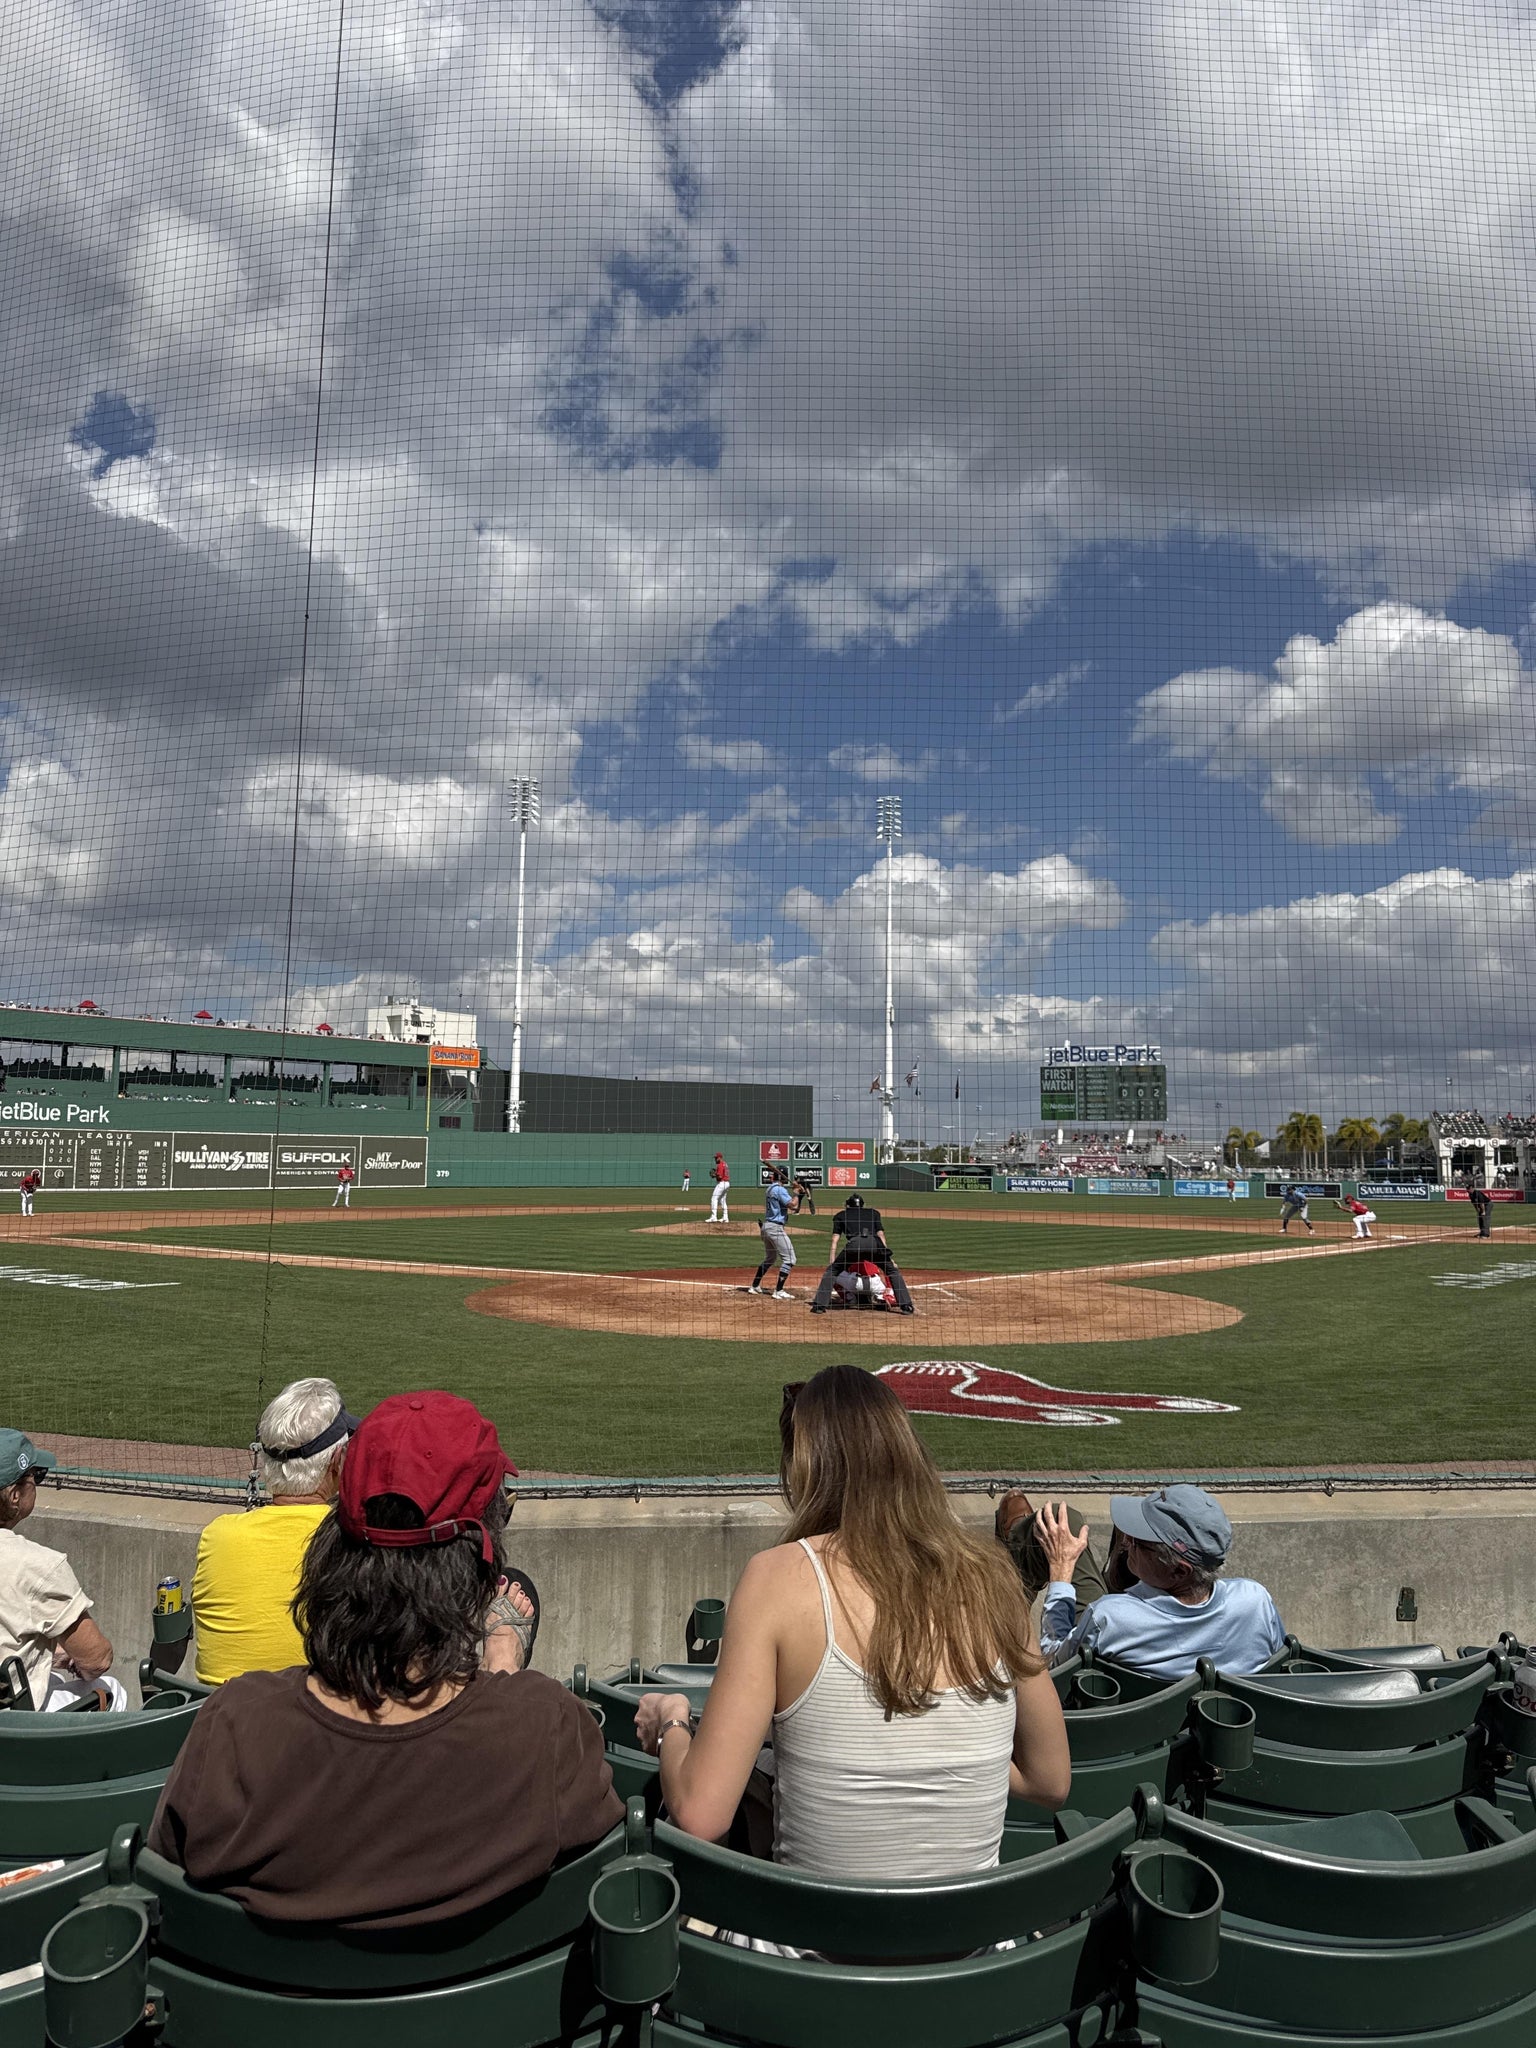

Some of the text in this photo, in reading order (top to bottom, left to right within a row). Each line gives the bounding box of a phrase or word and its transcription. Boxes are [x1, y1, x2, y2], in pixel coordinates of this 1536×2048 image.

[1048, 1045, 1158, 1066] jetBlue Park
[1044, 1069, 1072, 1080] FIRST
[1041, 1080, 1074, 1091] WATCH
[1153, 1089, 1160, 1097] 2
[67, 1104, 110, 1124] Park
[78, 1132, 132, 1140] LEAGUE
[174, 1151, 269, 1163] SULLIVAN TIRE
[281, 1152, 351, 1163] SUFFOLK
[377, 1152, 392, 1161] MY
[798, 1151, 819, 1159] NESN
[364, 1158, 423, 1170] Shower Door
[436, 1170, 450, 1178] 379
[1360, 1185, 1427, 1196] SAMUEL ADAMS
